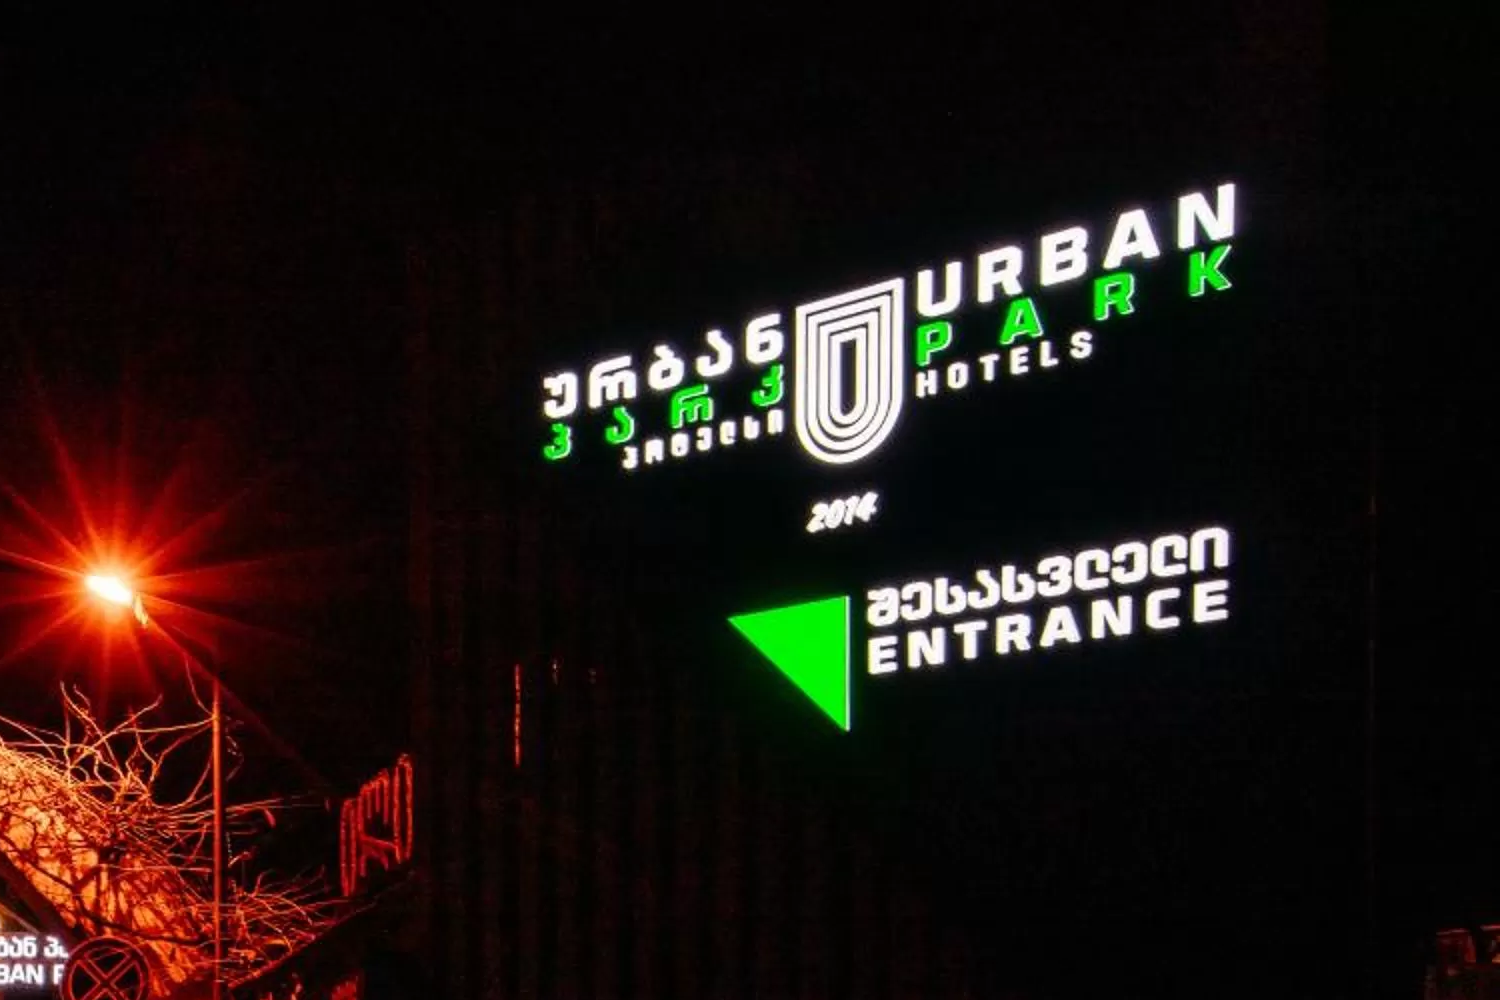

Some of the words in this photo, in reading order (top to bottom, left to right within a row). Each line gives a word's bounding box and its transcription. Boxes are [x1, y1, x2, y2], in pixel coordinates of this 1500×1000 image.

[916, 182, 1236, 318] URBAN
[915, 244, 1232, 368] PARK
[543, 312, 785, 419] ურბან
[543, 363, 784, 461] პარკ
[915, 330, 1093, 399] HOTELS
[806, 491, 879, 533] 2014
[867, 526, 1230, 628] შესასვლელი
[867, 579, 1230, 675] ENTRANCE
